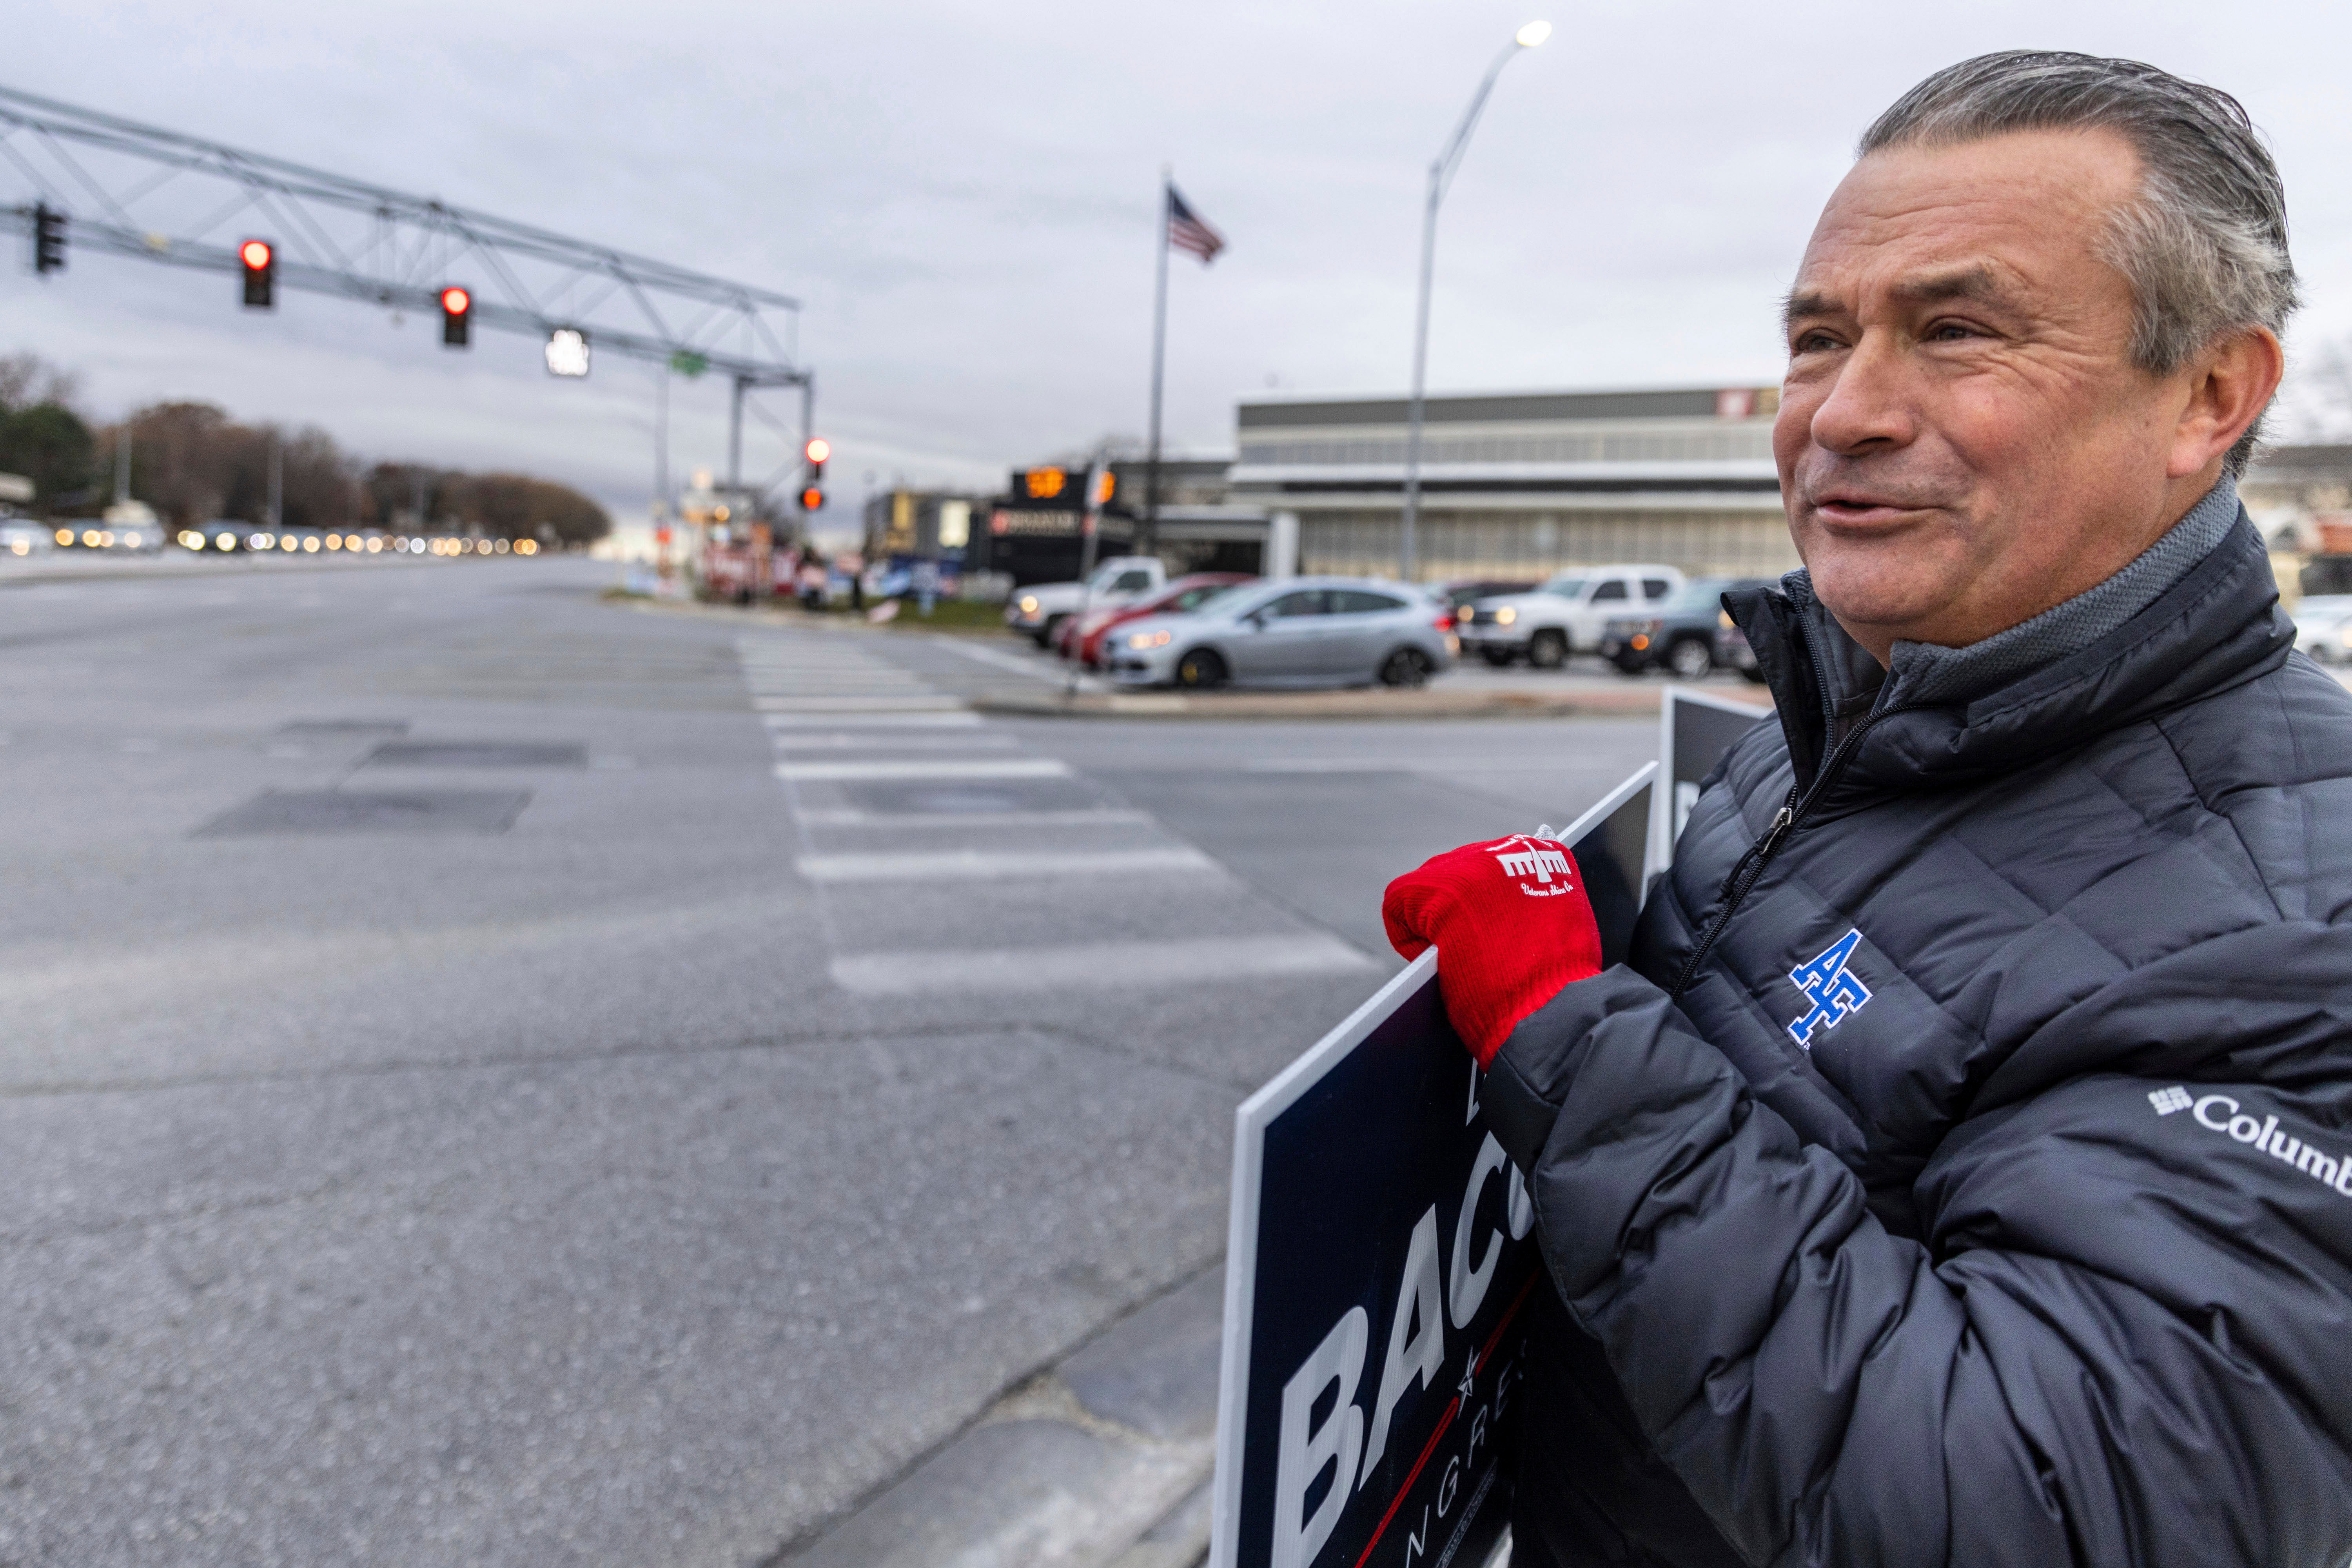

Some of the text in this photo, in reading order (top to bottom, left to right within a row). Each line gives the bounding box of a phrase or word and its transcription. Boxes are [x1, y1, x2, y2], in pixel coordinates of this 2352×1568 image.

[1521, 880, 1573, 896] Veterans Shine On
